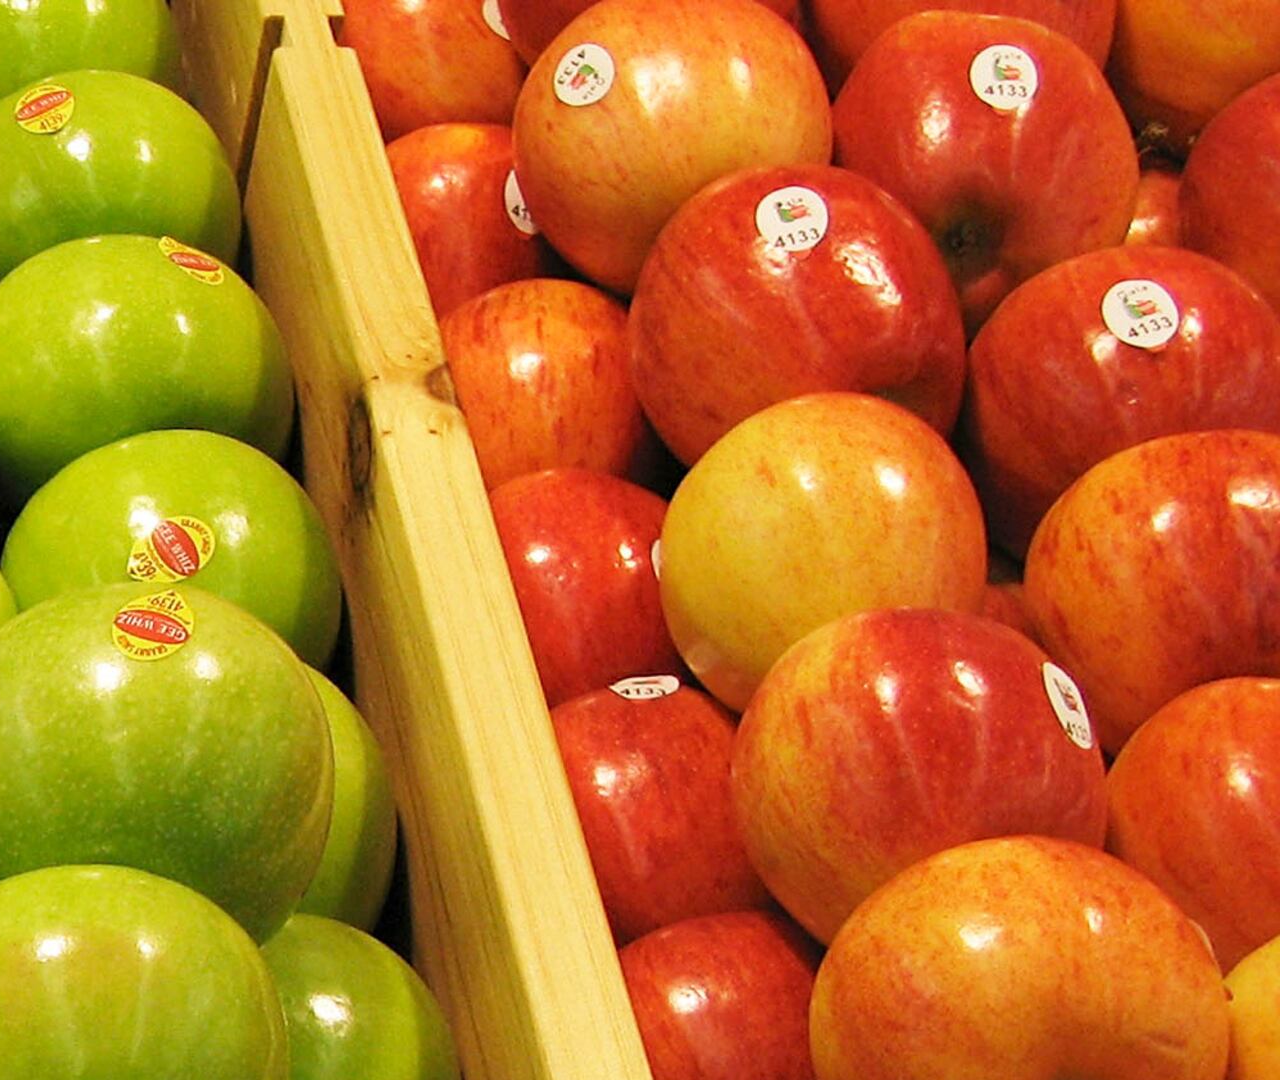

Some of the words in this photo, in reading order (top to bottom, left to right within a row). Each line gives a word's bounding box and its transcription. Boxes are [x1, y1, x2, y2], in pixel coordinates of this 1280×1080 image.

[984, 84, 1027, 98] 4133
[774, 228, 820, 248] 4133
[1128, 316, 1173, 338] 4133
[159, 524, 176, 547] GEE
[171, 543, 197, 574] WHIZ
[150, 596, 185, 612] 4139
[116, 613, 156, 630] WHIZ
[159, 623, 187, 642] GEE
